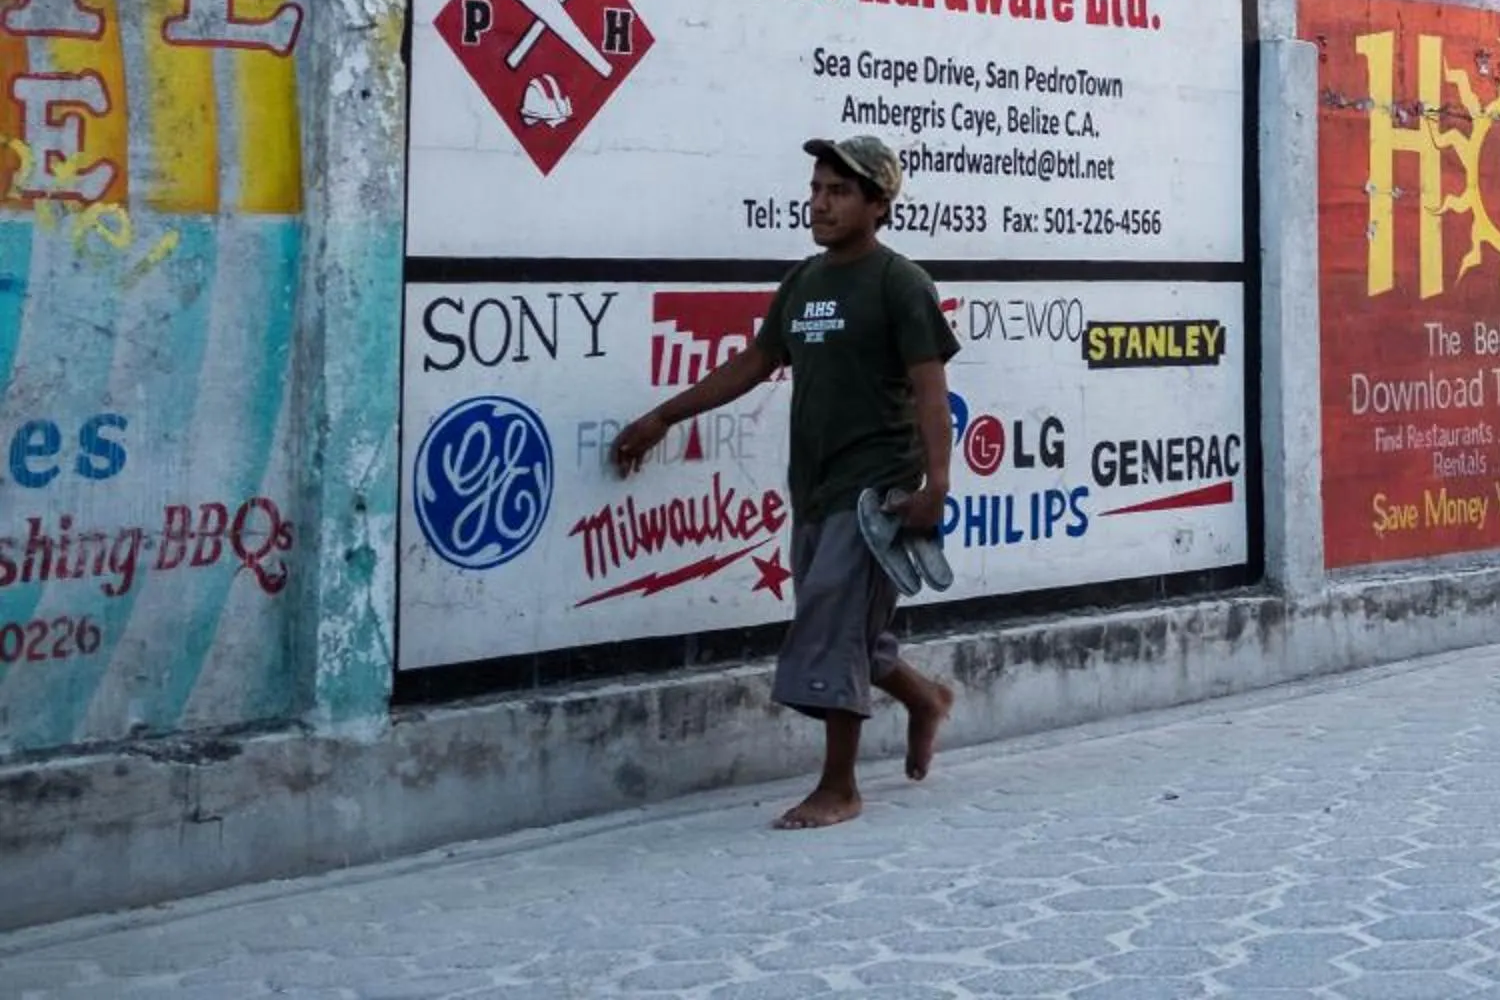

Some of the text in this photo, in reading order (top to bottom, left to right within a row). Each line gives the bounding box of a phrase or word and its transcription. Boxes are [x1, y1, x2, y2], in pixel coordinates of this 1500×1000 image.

[602, 7, 635, 55] H
[813, 47, 851, 77] Sea
[857, 50, 917, 88] Grape
[924, 56, 980, 92] Drive,
[985, 61, 1019, 91] San
[841, 95, 1100, 139] Ambergris Caye, Belize C.A.
[900, 143, 1115, 181] sphardwareltd@btl.net
[743, 199, 781, 229] Tel:
[1002, 205, 1039, 233] Fax:
[1043, 208, 1162, 236] 501-226-4566
[423, 292, 619, 372] SONY
[1088, 325, 1220, 361] STANLEY
[1424, 322, 1462, 357] The
[1351, 368, 1484, 416] Download
[1013, 416, 1065, 469] LG
[1091, 434, 1241, 487] GENERAC
[1375, 425, 1403, 452] Find
[1433, 450, 1487, 479] Rentals
[568, 472, 787, 581] Milwaukee
[940, 486, 1089, 547] PHILIPS
[1373, 492, 1418, 533] Save
[1424, 487, 1489, 530] Money
